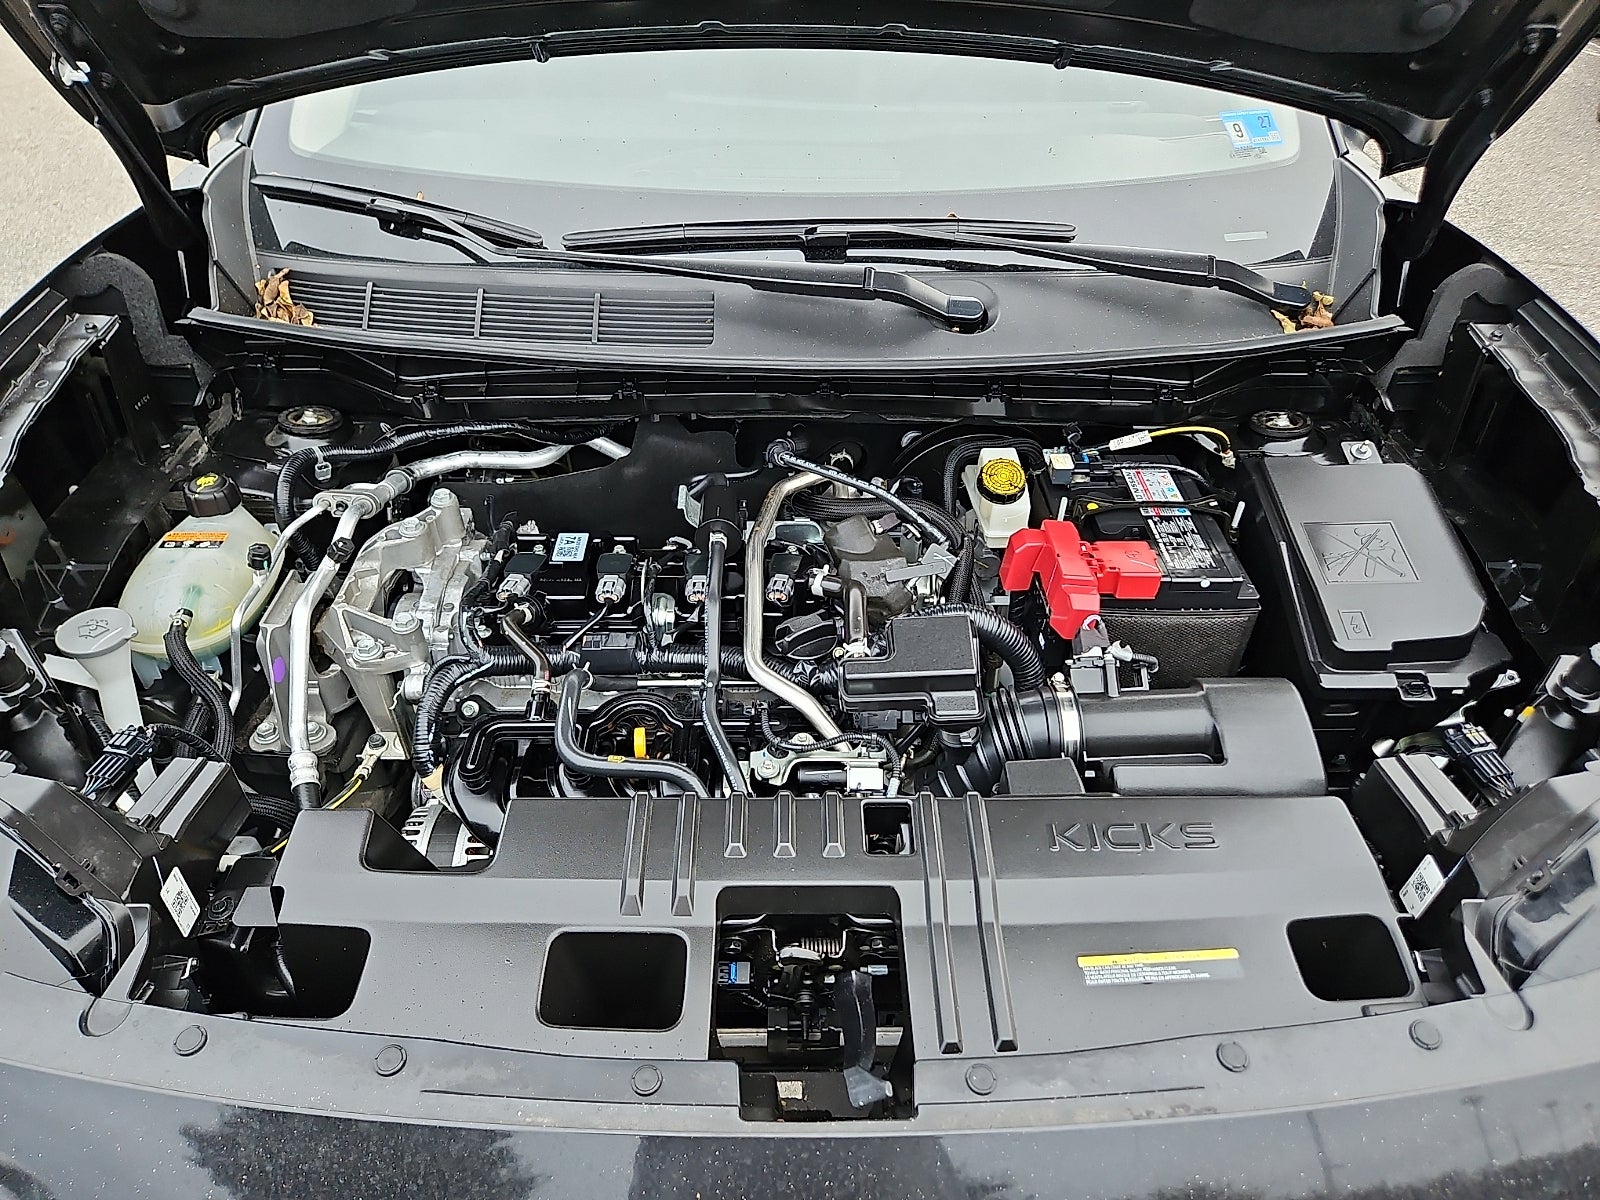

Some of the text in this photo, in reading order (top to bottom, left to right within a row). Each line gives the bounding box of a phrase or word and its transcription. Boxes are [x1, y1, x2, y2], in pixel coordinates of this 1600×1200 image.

[1257, 115, 1272, 129] 27
[1232, 123, 1244, 138] 9
[1046, 822, 1220, 851] KICKS
